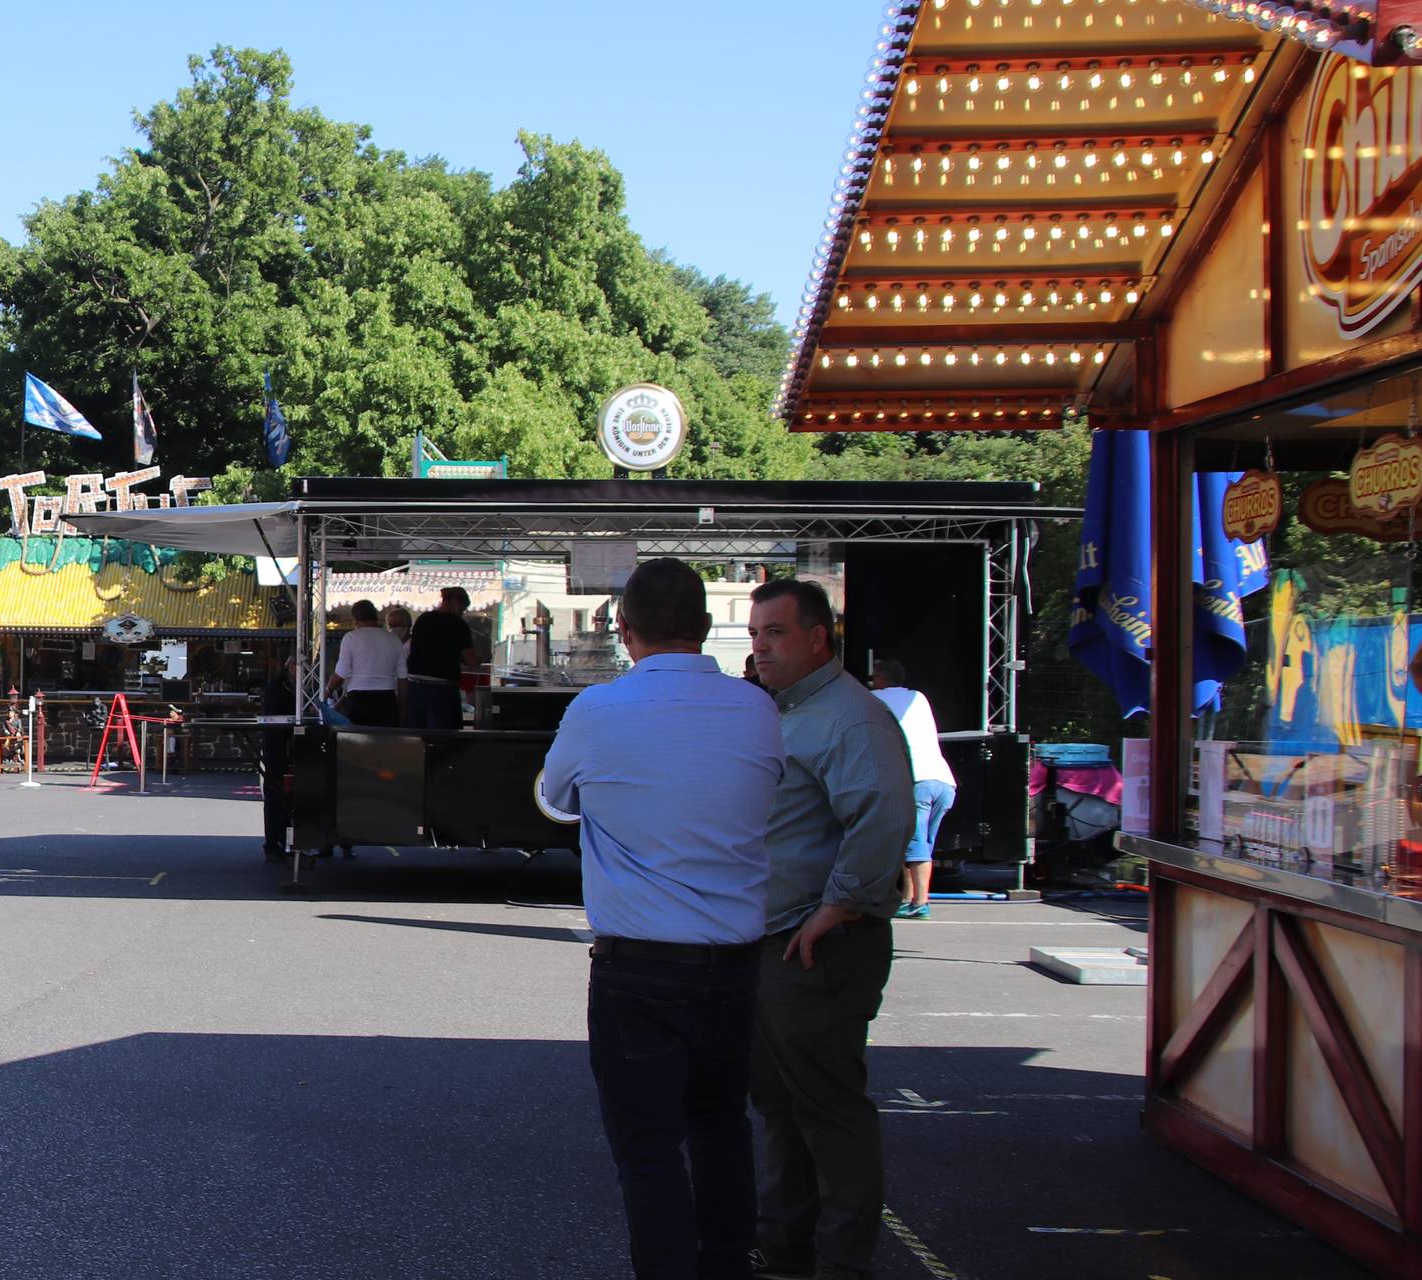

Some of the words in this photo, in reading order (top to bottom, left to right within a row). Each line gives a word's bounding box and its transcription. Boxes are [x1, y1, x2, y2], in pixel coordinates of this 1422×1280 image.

[633, 448, 657, 457] UNTER
[1355, 455, 1422, 498] CHURROS
[1227, 488, 1277, 523] CHURROS
